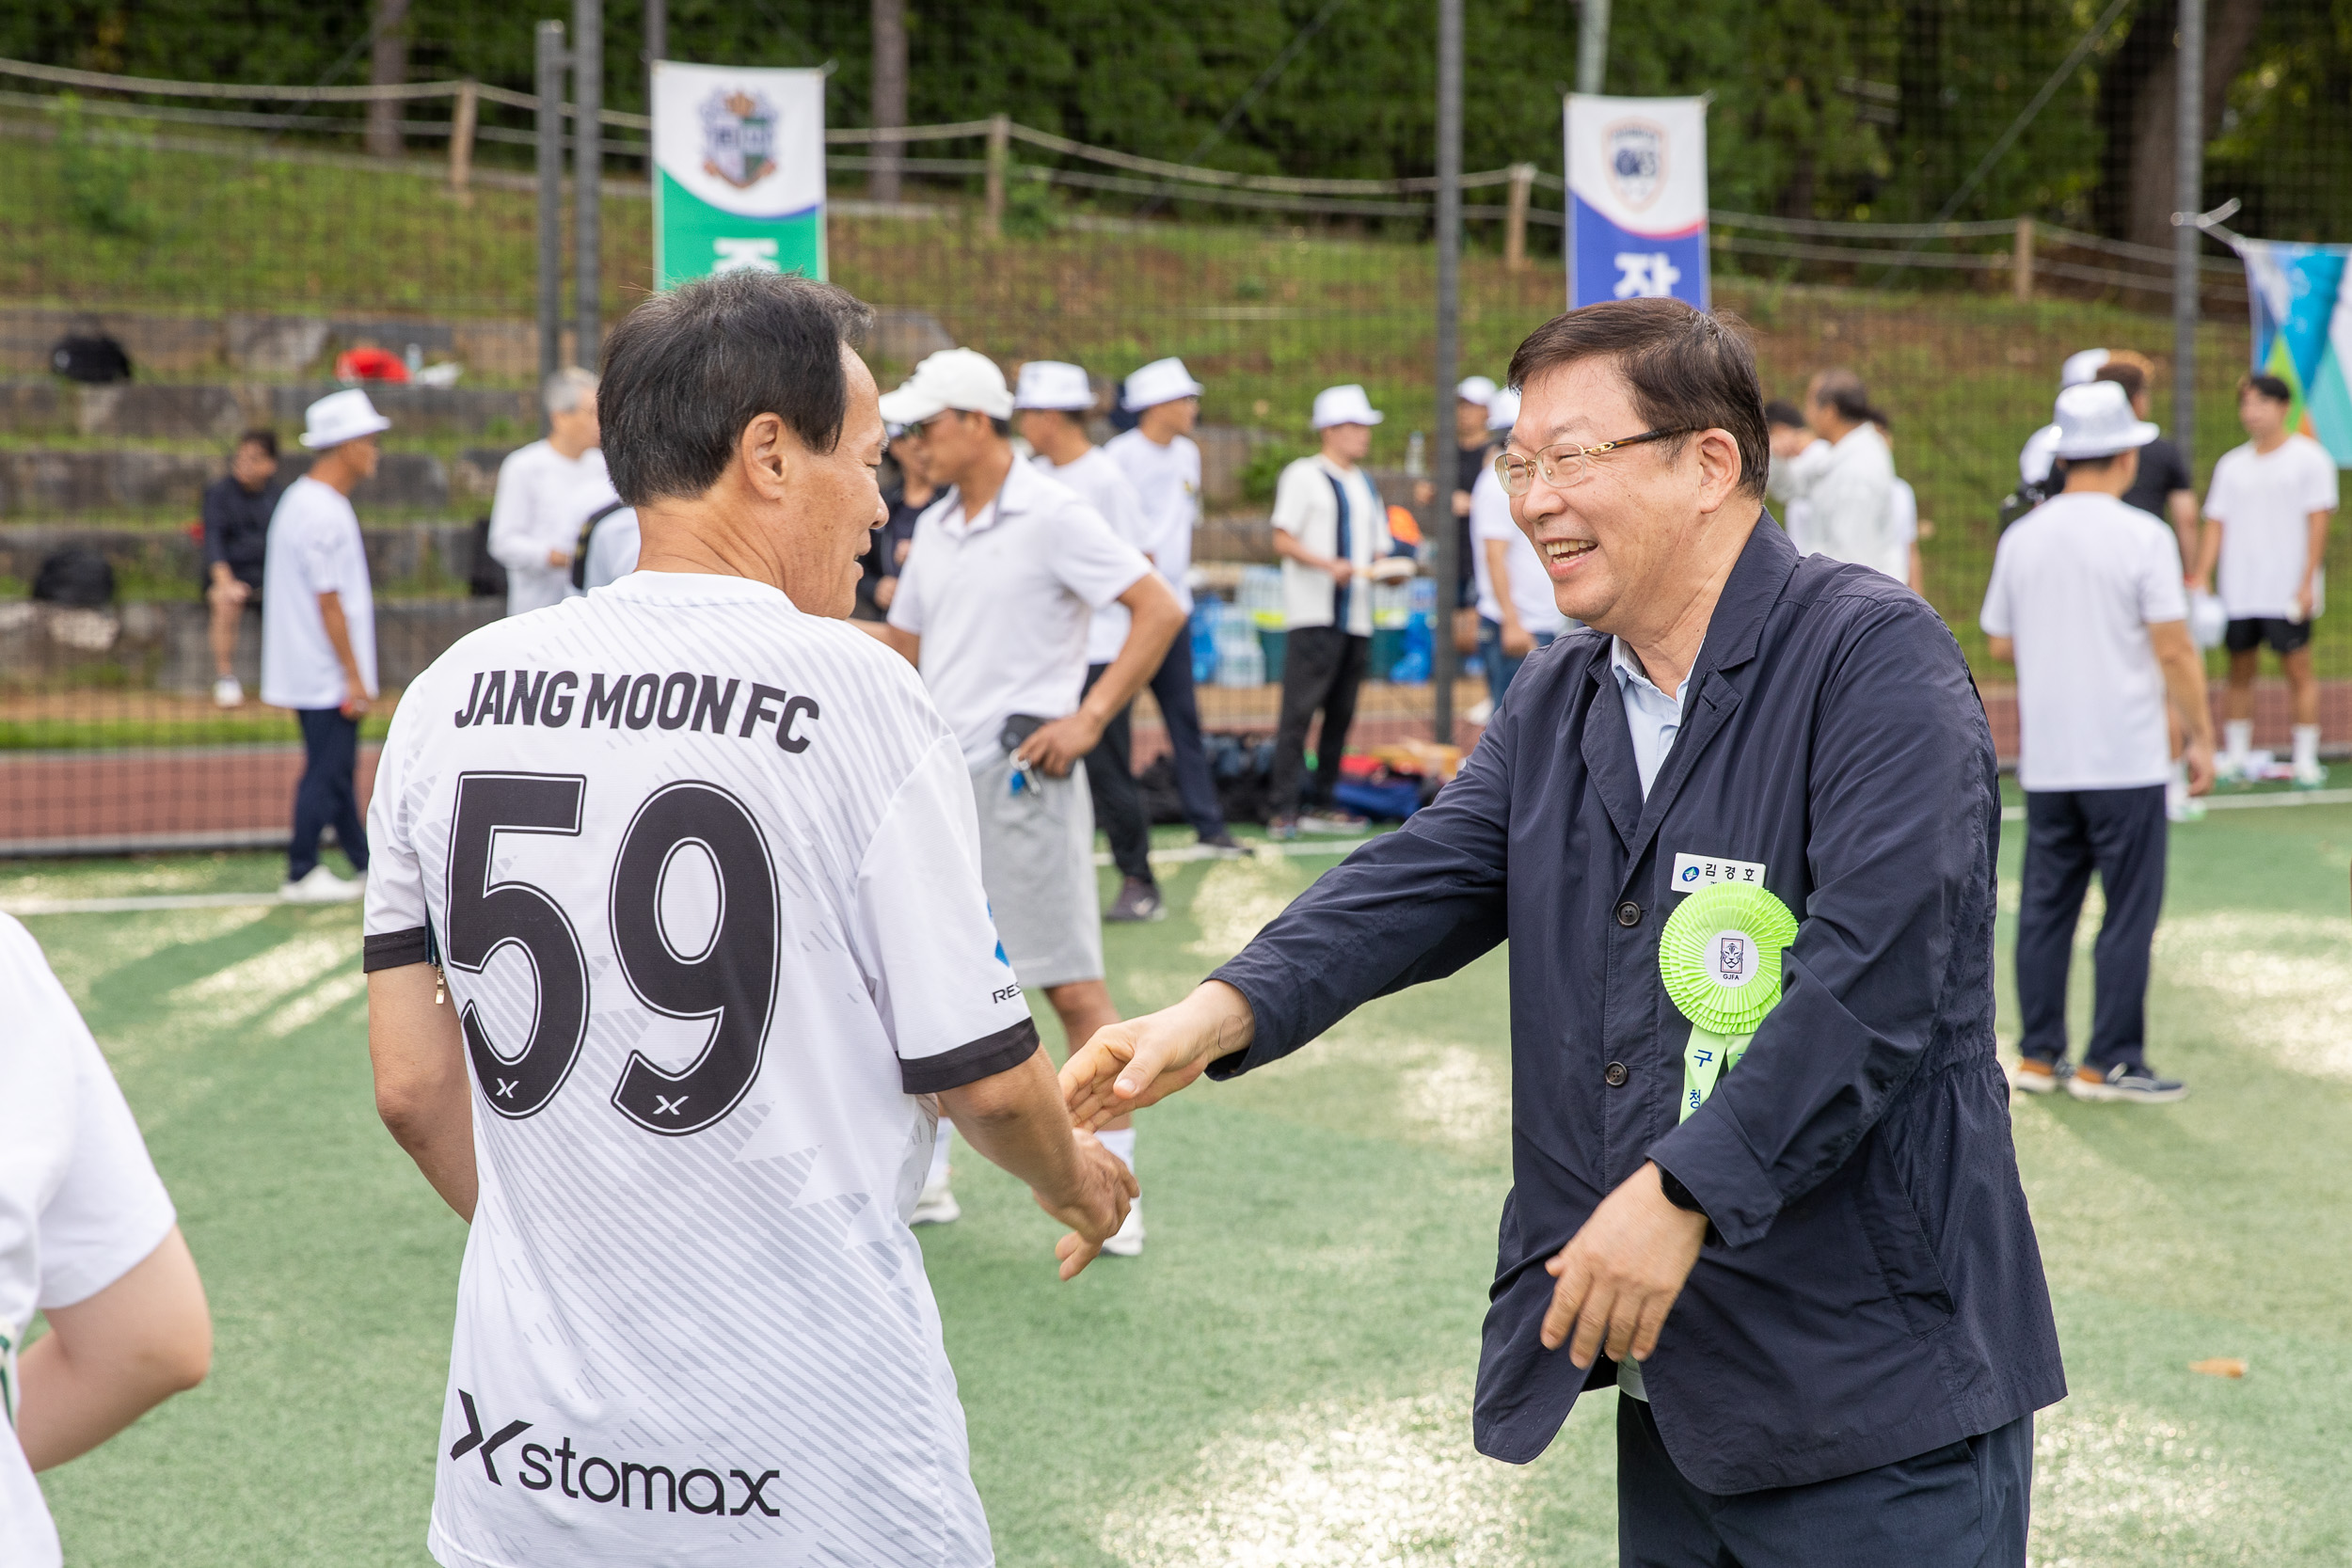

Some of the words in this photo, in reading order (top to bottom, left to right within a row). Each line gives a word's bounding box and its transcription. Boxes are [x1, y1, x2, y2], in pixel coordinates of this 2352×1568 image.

[454, 670, 579, 729] JANG
[580, 672, 740, 735] MOON
[739, 682, 820, 754] FC
[1705, 863, 1755, 881] 김경호
[446, 771, 781, 1137] 59
